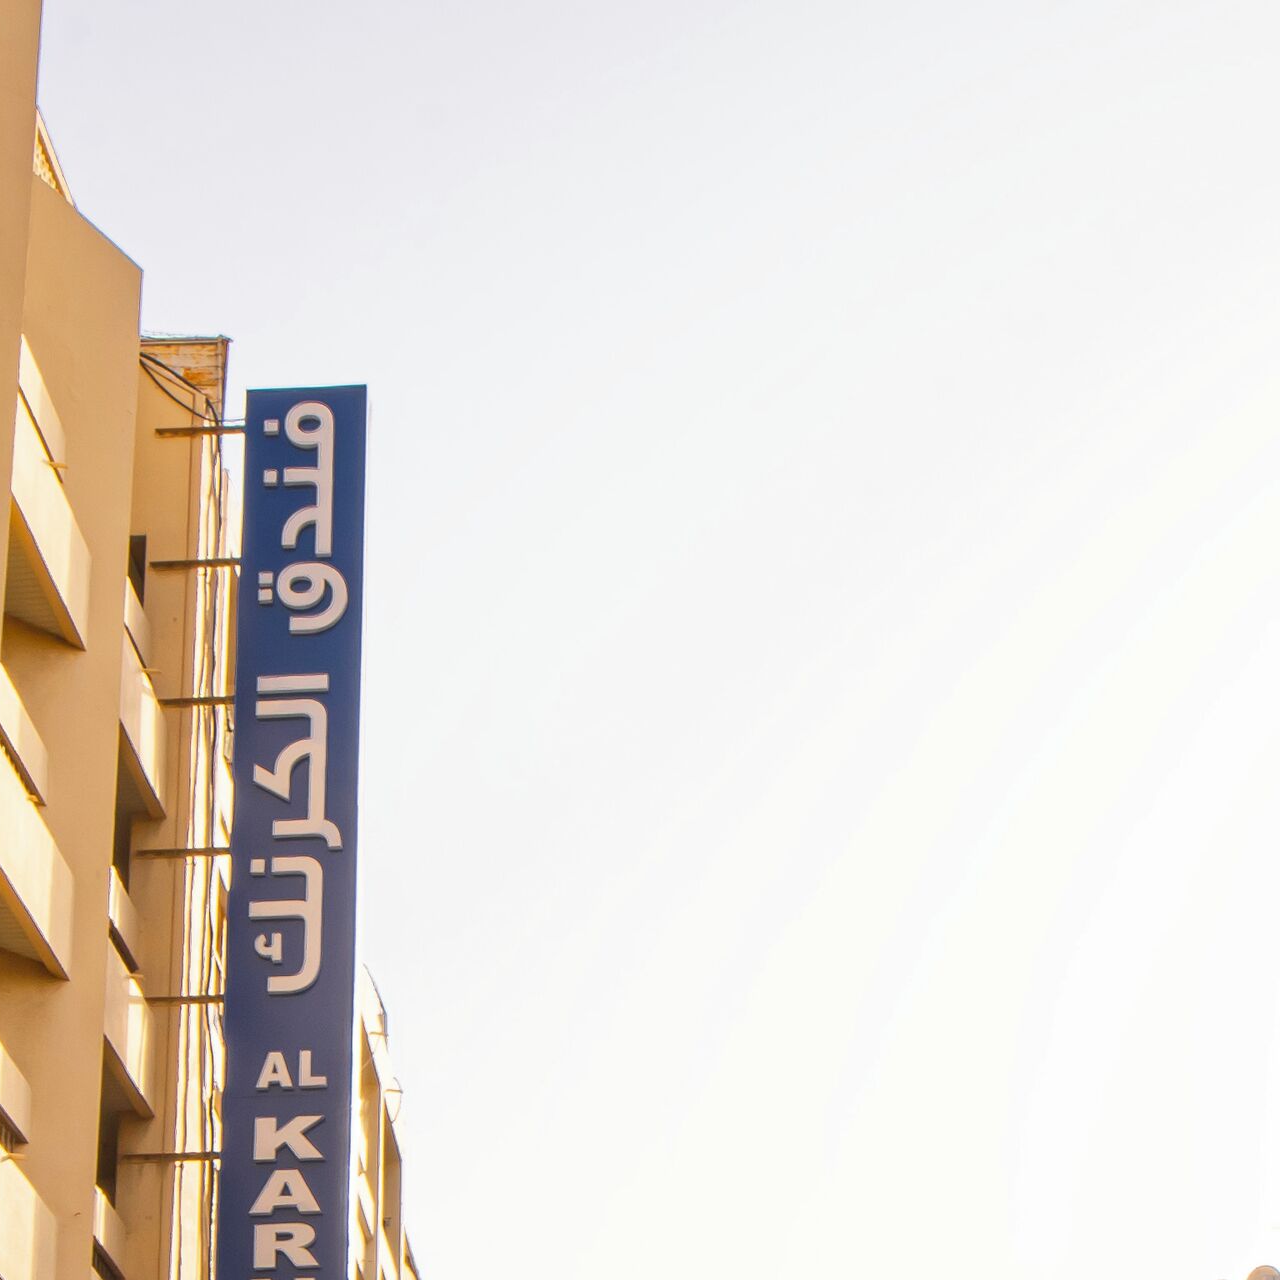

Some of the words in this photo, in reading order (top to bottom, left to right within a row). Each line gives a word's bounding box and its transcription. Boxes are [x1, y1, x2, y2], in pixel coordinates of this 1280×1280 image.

[258, 401, 349, 635] فندق
[248, 673, 344, 995] الكرنك
[255, 1050, 328, 1090] AL
